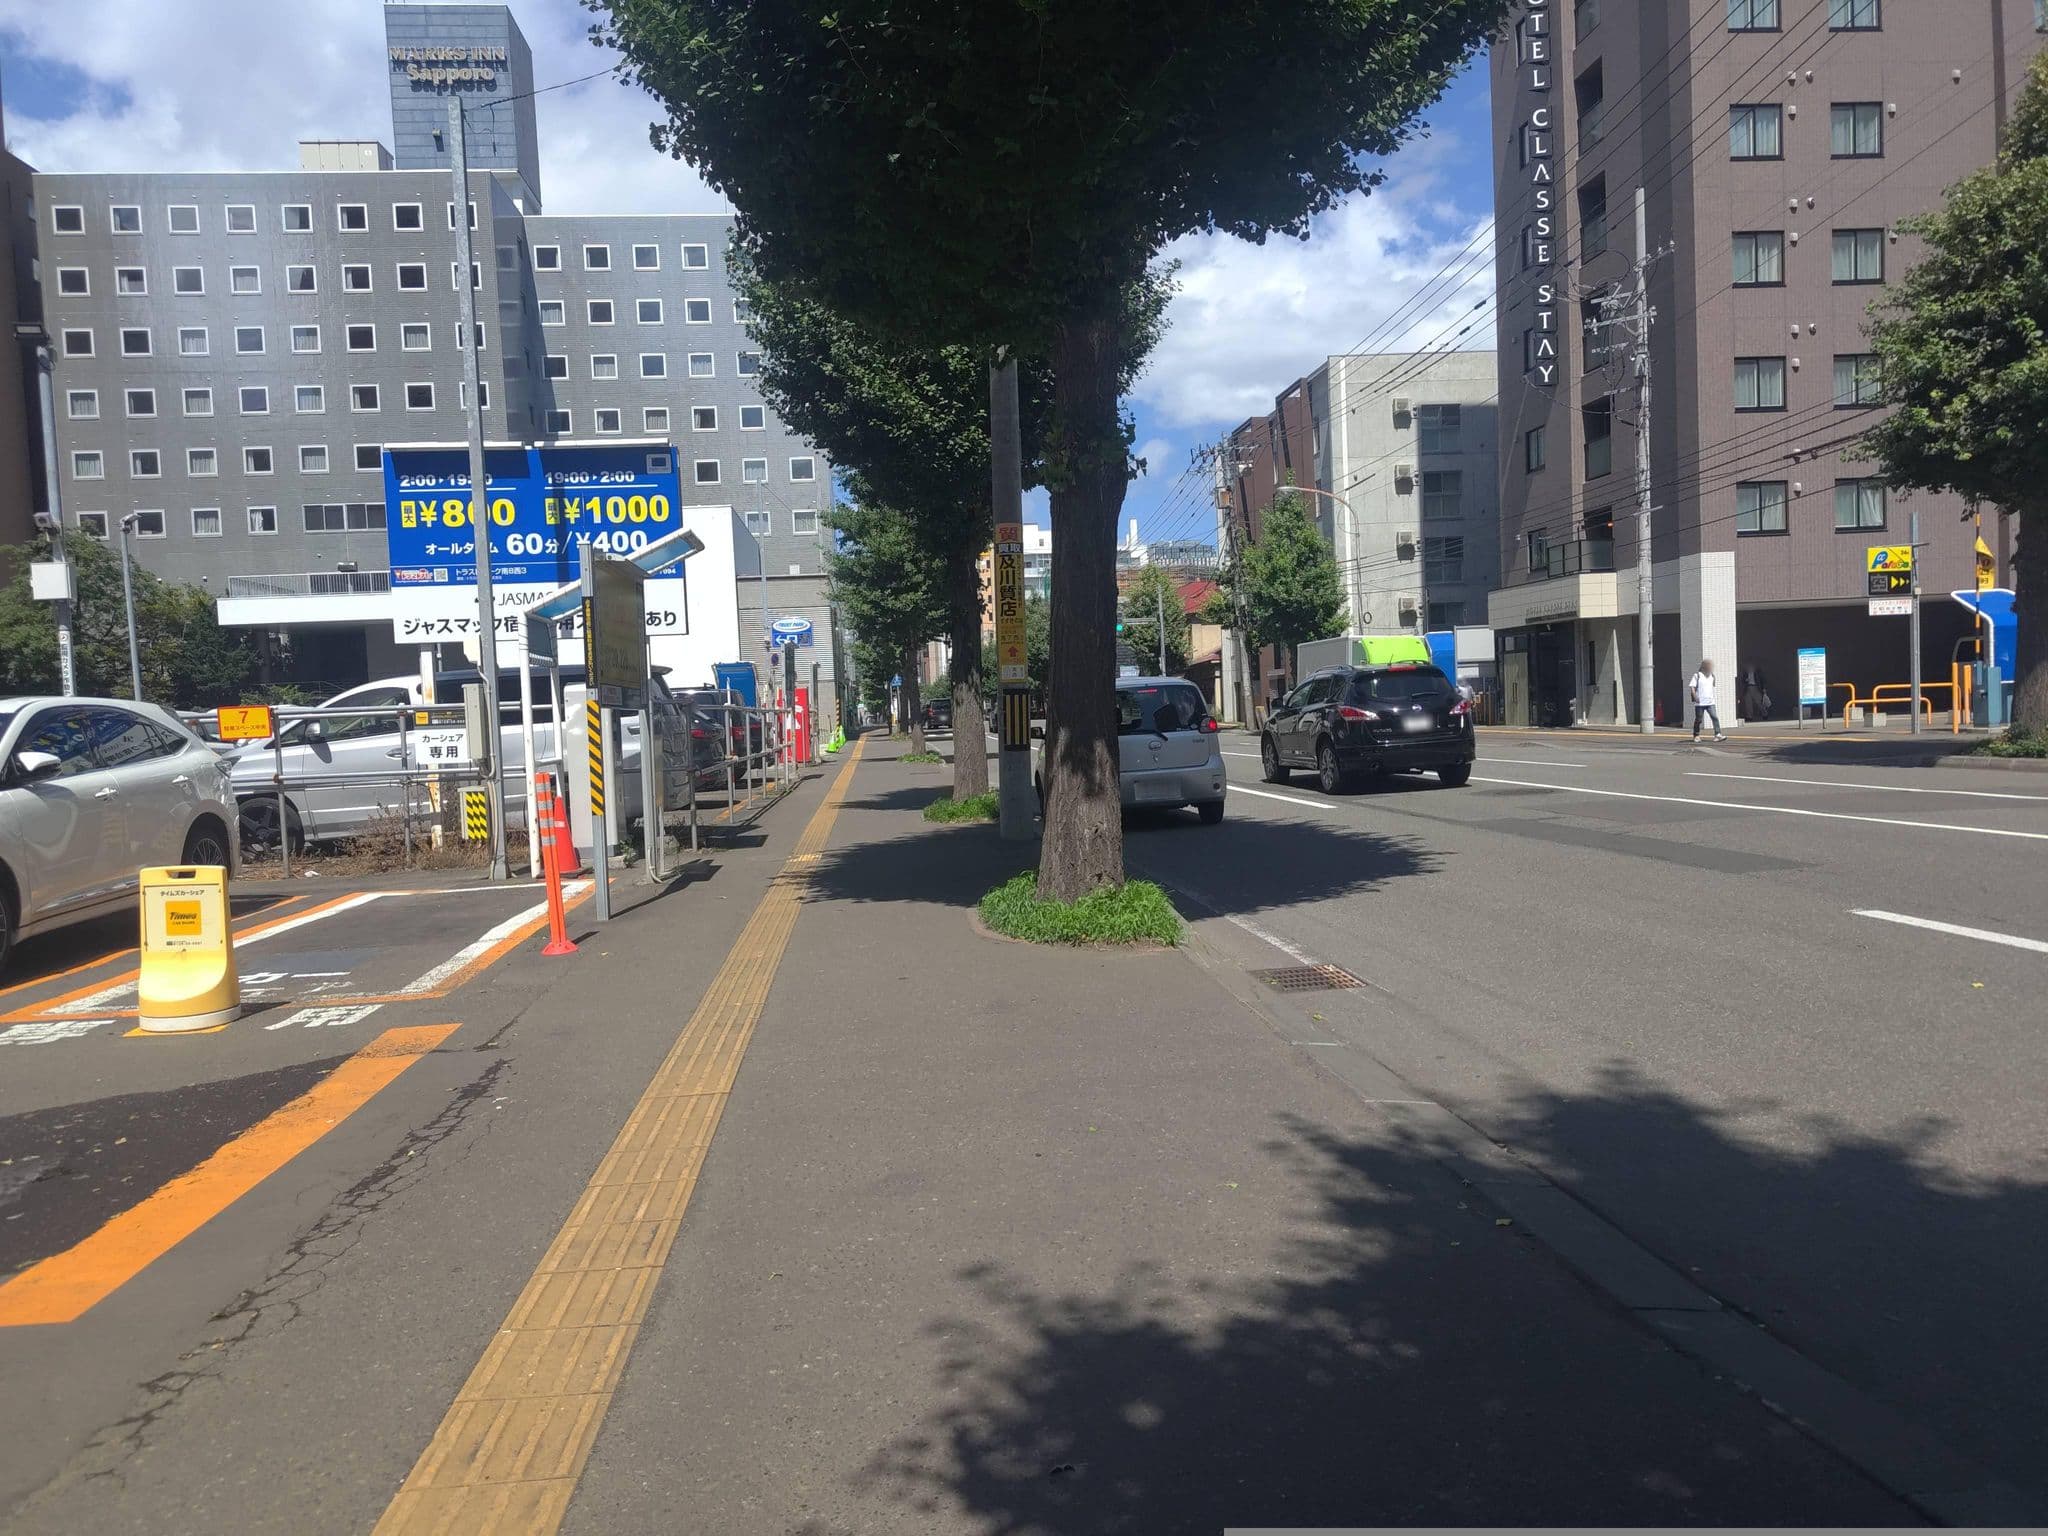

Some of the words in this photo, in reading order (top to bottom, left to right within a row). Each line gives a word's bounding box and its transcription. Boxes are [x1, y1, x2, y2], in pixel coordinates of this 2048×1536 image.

[406, 63, 495, 84] Sapporo
[1527, 0, 1546, 88] TEL
[1538, 284, 1555, 383] STAY
[400, 474, 436, 487] 2:00
[447, 473, 493, 486] 19:0
[544, 471, 590, 484] 19:00
[600, 470, 635, 483] 2:00
[564, 494, 669, 524] ¥1000
[425, 542, 499, 555] オールタム
[238, 710, 249, 724] 7
[421, 733, 464, 744] カーシェア
[428, 745, 459, 759] 専用
